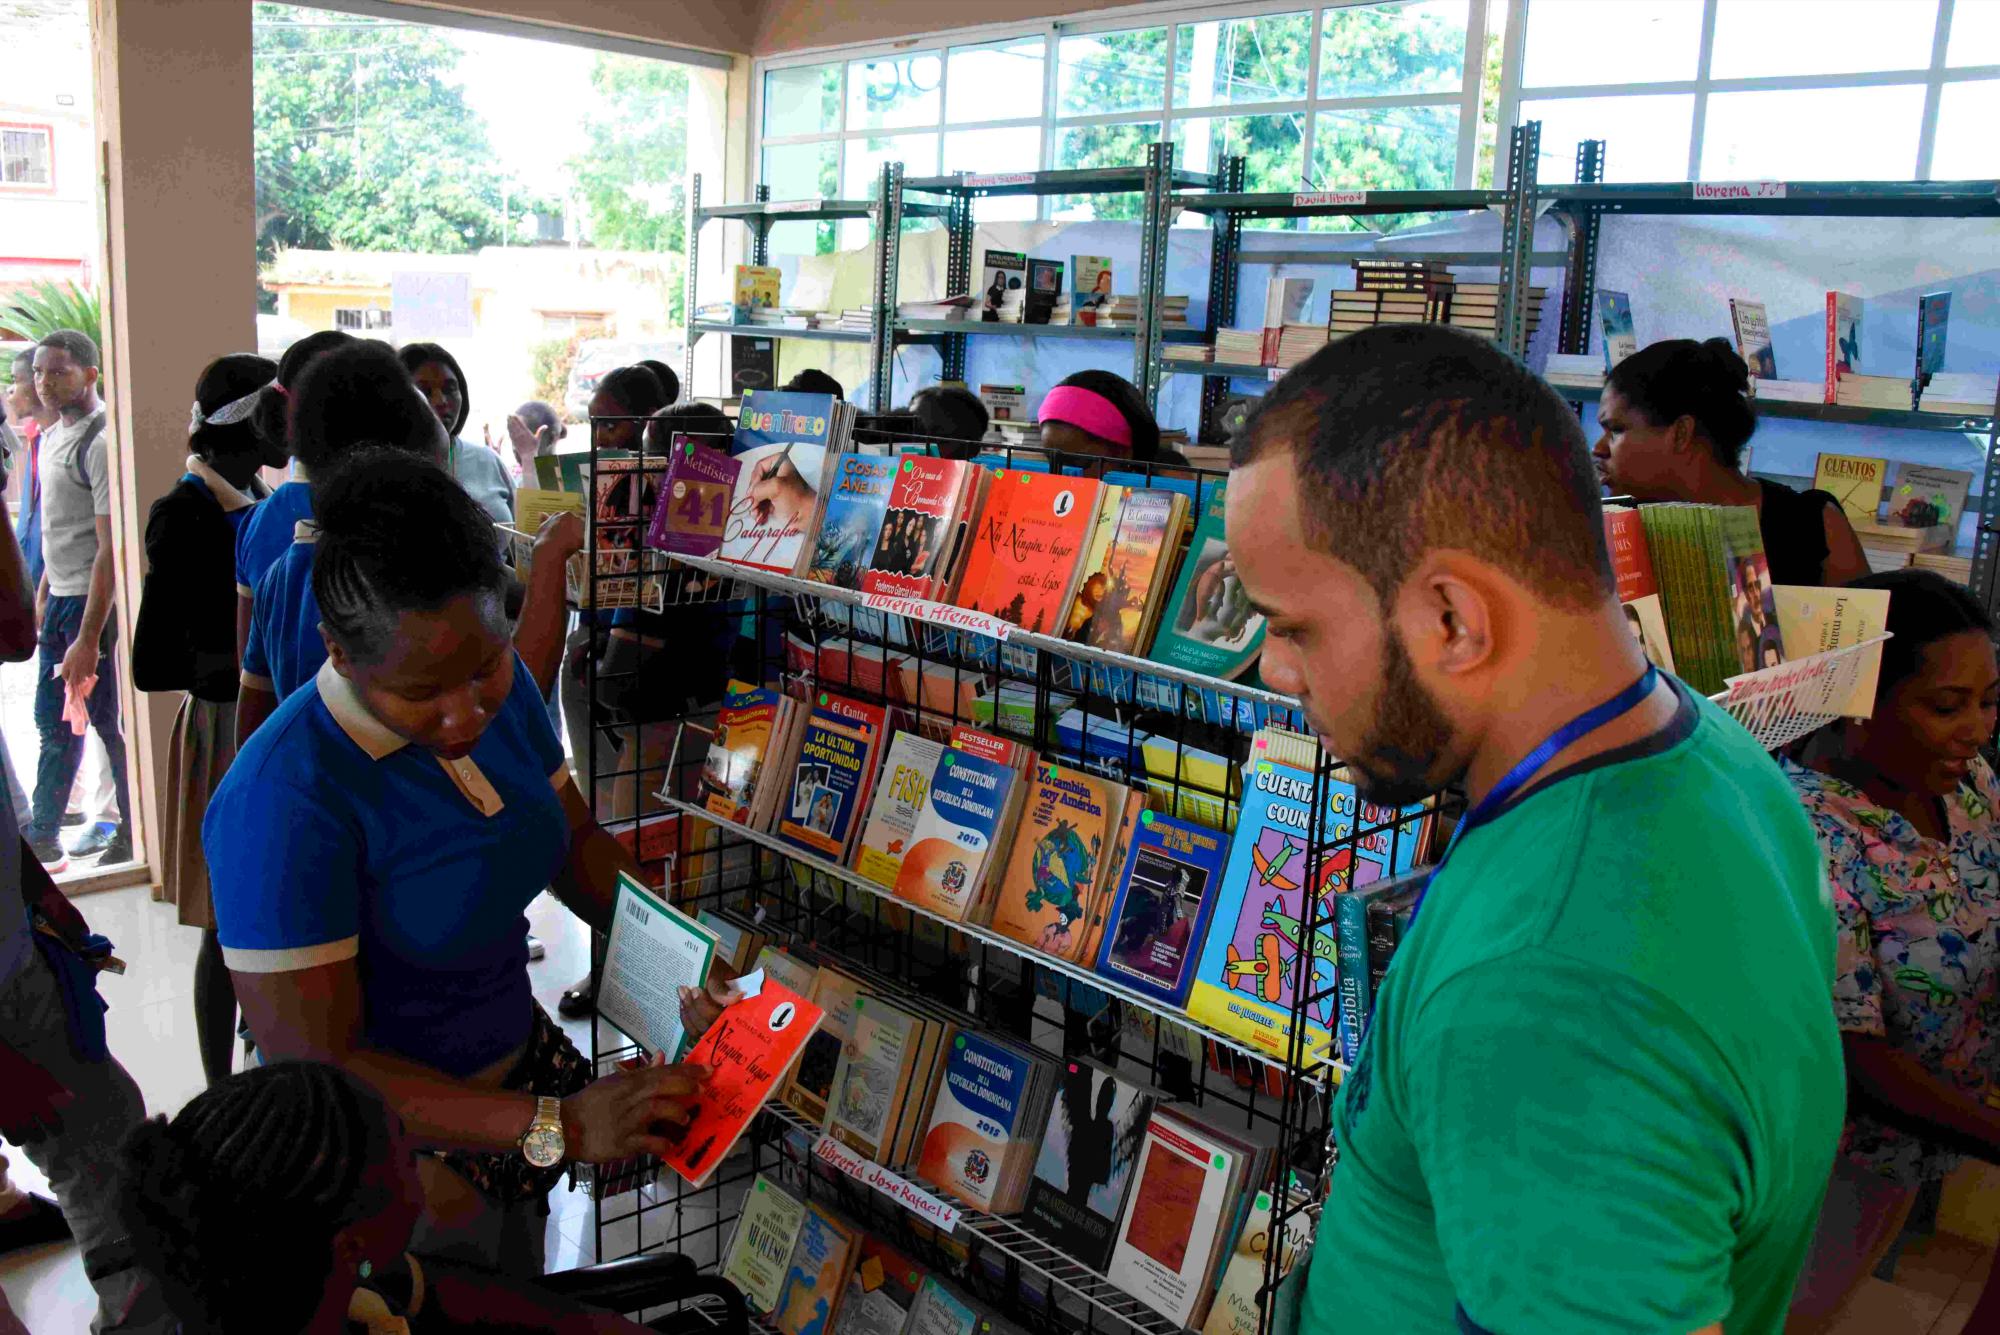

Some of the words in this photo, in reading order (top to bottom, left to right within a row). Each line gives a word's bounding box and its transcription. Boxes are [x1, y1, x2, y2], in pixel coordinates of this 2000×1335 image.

[1295, 195, 1326, 206] David
[844, 458, 888, 477] COSAS
[1824, 457, 1877, 478] CUENTOS
[1040, 570, 1062, 596] lejos
[929, 604, 991, 631] Atenea
[1835, 597, 1848, 617] Los
[1827, 620, 1841, 650] mang
[815, 731, 826, 745] LA
[827, 734, 857, 753] ÚLTIMA
[959, 731, 1004, 751] BESTSELLER
[803, 742, 861, 771] OPORTUNIDAD
[949, 764, 998, 790] CONSTITUCIÓN
[1037, 766, 1052, 785] Yo
[961, 798, 994, 819] DOMINICANA
[1040, 788, 1059, 804] soy
[1059, 792, 1102, 817] América
[1266, 803, 1316, 831] COUN
[956, 831, 981, 846] 2015
[1340, 977, 1358, 1026] Biblia
[1228, 1002, 1241, 1014] LOS
[1240, 1008, 1276, 1028] JUGUETES
[963, 1049, 1013, 1082] CONSTITUCIÓN
[949, 1071, 979, 1096] REPÚBLICA
[977, 1085, 1012, 1113] DOMINICANA
[976, 1119, 1001, 1137] 2015
[900, 1187, 942, 1217] Rafael
